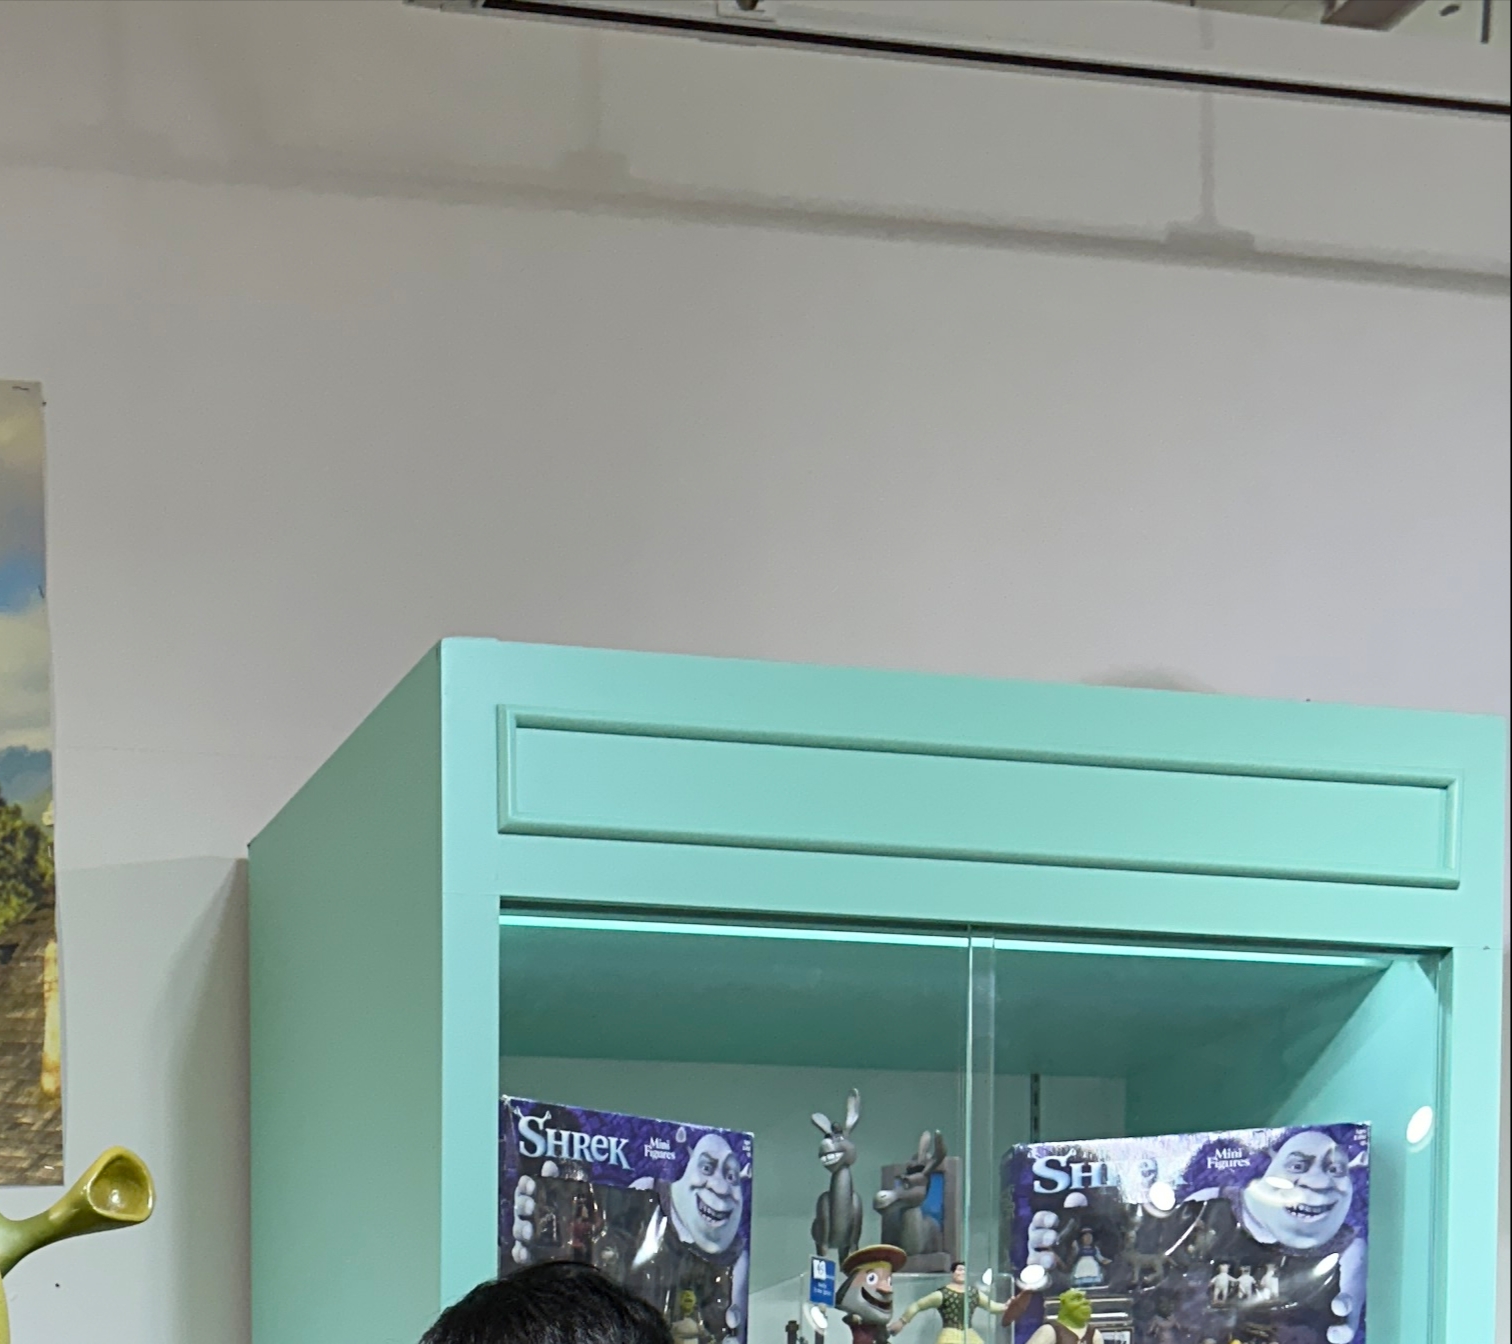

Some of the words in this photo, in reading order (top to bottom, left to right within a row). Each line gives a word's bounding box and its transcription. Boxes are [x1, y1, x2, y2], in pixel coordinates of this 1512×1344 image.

[649, 1136, 671, 1150] Mini
[644, 1144, 676, 1161] Figures
[1214, 1147, 1243, 1161] Mini
[1207, 1156, 1251, 1170] Figures
